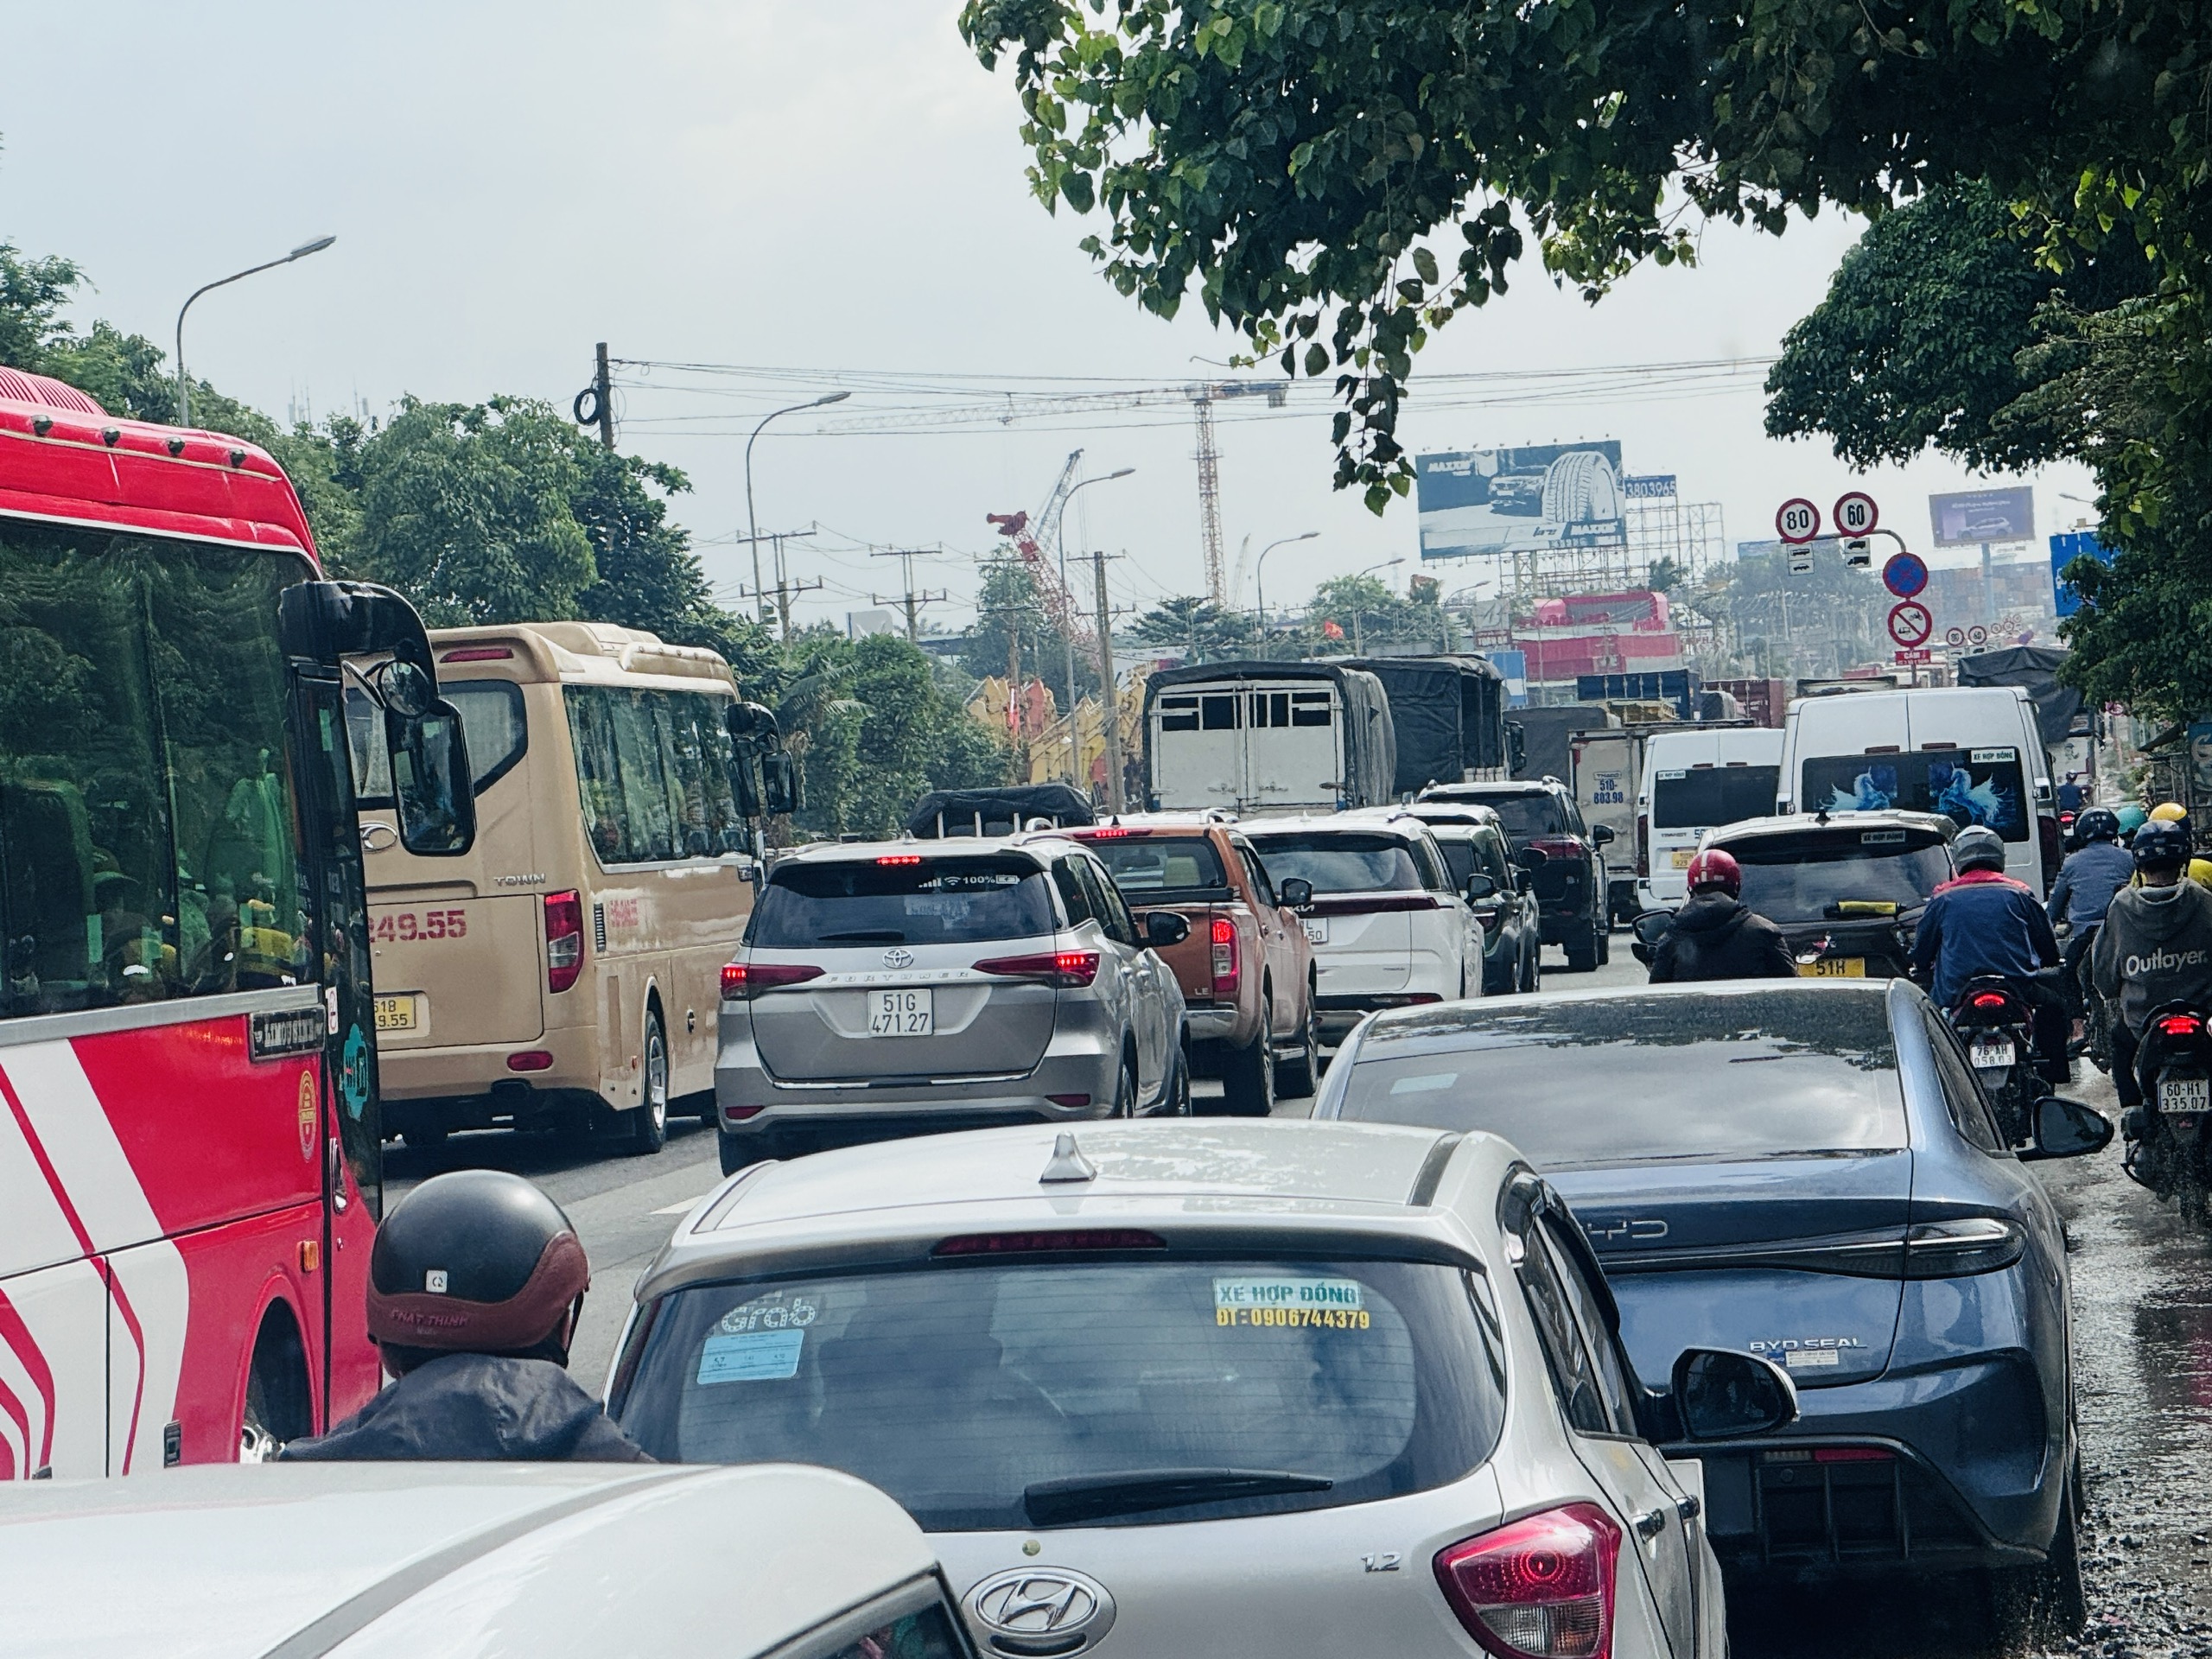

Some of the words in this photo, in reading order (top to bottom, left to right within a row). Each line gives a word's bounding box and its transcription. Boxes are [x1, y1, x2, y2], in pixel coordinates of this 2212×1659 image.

[1626, 480, 1676, 499] 3803965
[1786, 509, 1809, 530] 80
[1847, 504, 1866, 526] 60
[493, 873, 545, 887] TOWN
[963, 875, 995, 884] 100%
[828, 971, 969, 983] FORTUNER
[1816, 960, 1846, 975] 51H
[883, 993, 916, 1012] 51G
[375, 1014, 408, 1027] 9.55
[872, 1013, 929, 1033] 471.27
[264, 1019, 315, 1047] LIMOUSINE
[2167, 1083, 2200, 1096] 60-H1
[2162, 1096, 2206, 1110] 335.07
[1587, 1220, 1669, 1241] YD
[1220, 1286, 1245, 1302] XE
[1251, 1284, 1294, 1305] HỢP
[721, 1298, 816, 1332] Grab
[1750, 1341, 1798, 1352] BYD
[1804, 1338, 1867, 1350] SEAL
[1361, 1552, 1401, 1573] 1.2
